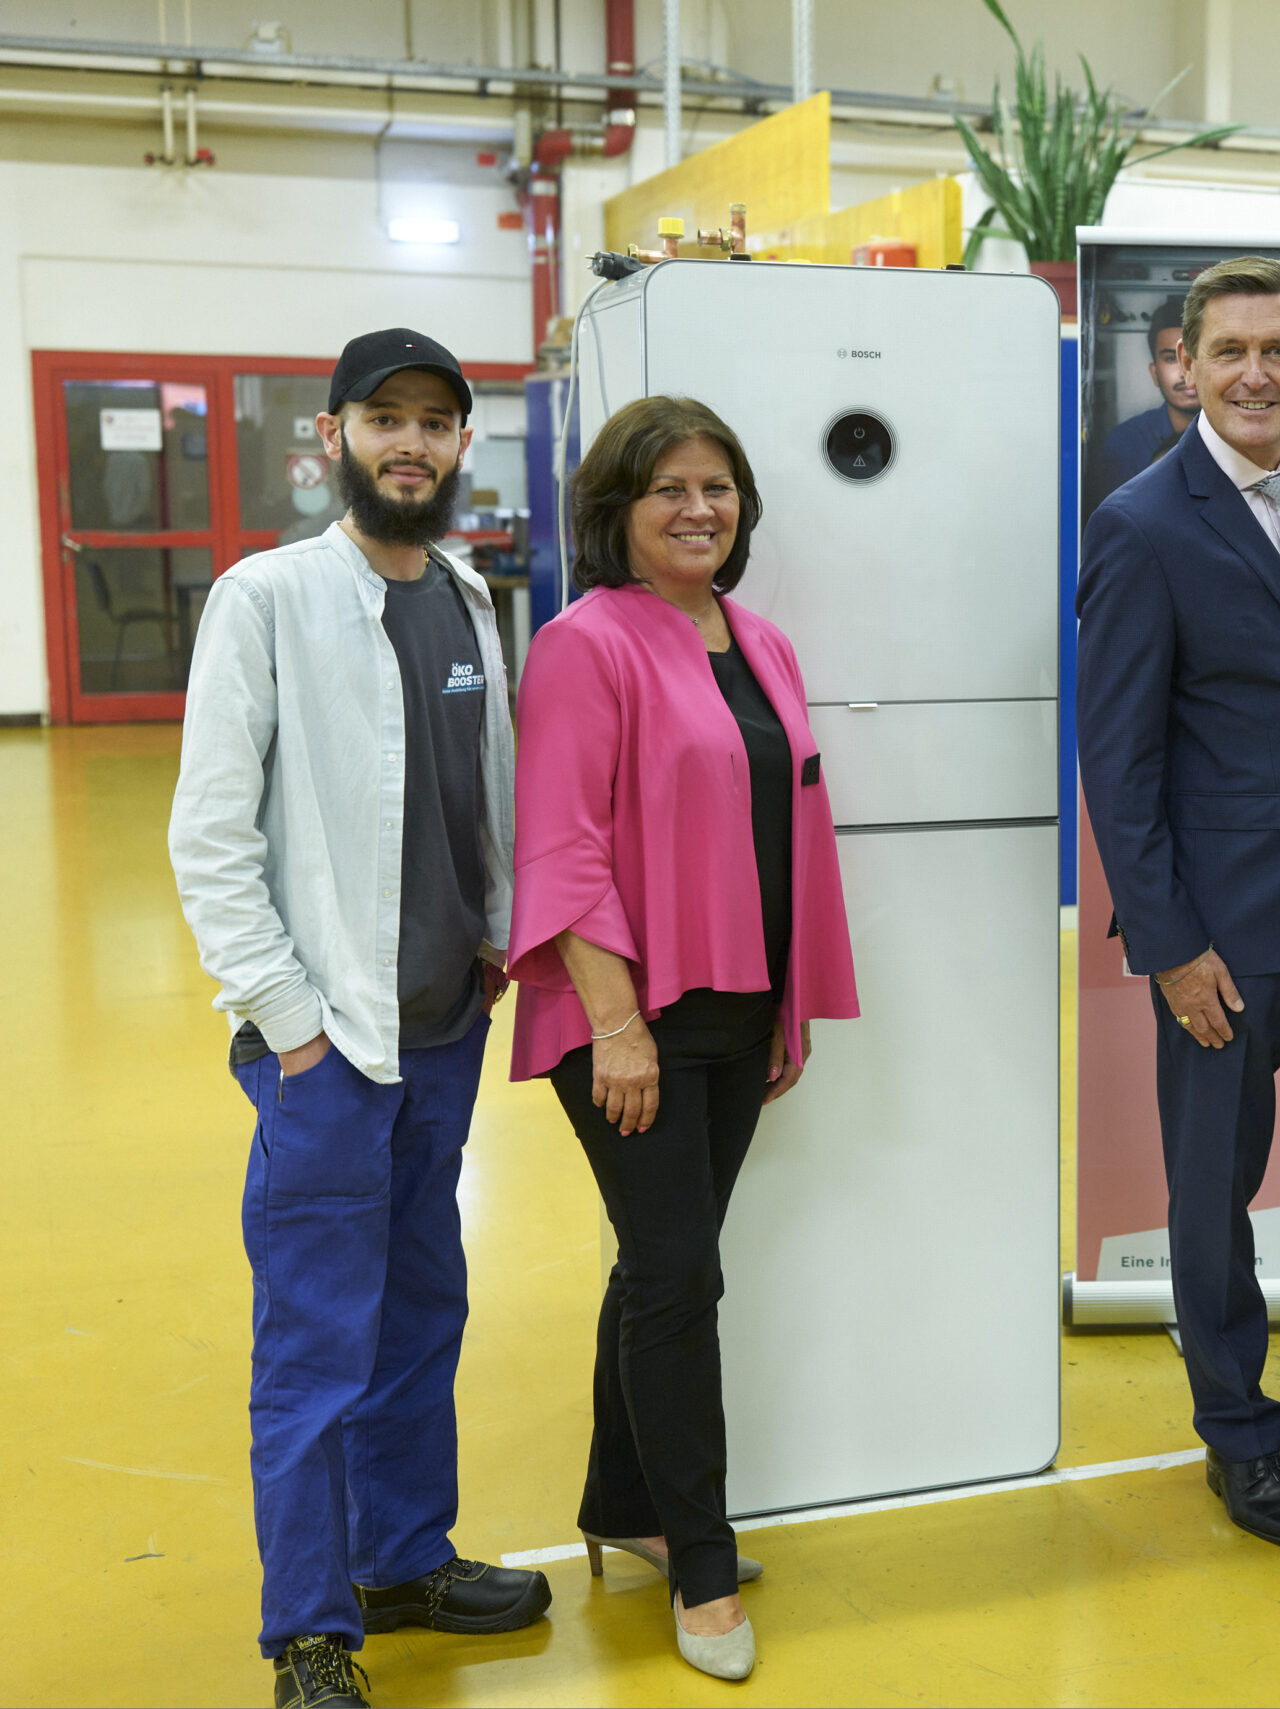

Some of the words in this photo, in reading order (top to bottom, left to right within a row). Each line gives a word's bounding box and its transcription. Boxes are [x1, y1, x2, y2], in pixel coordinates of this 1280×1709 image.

[851, 350, 881, 359] BOSCH
[451, 662, 474, 677] ÖKO
[1121, 1256, 1154, 1268] Eine
